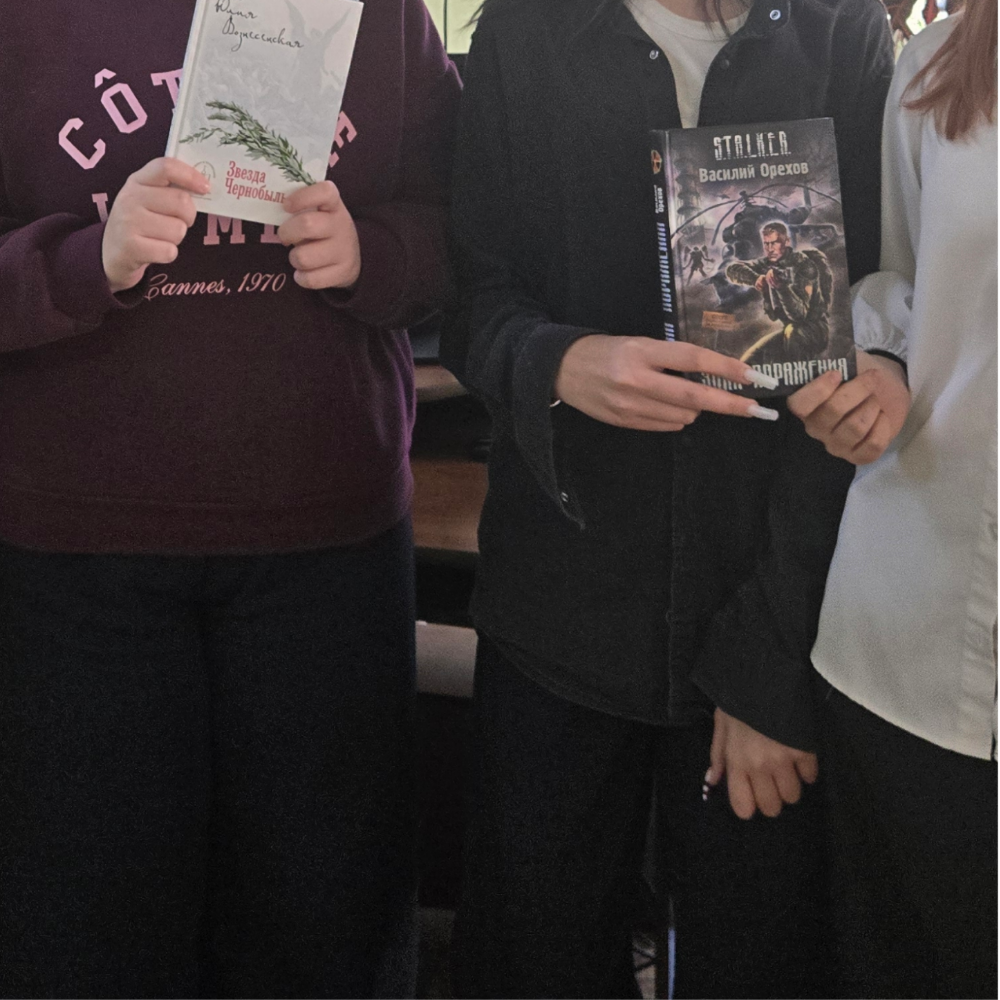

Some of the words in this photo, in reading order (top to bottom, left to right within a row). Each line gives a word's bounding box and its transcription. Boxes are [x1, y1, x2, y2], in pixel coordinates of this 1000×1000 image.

[222, 15, 304, 51] Вознесенская
[227, 160, 266, 185] Звезда
[699, 165, 755, 183] Василий
[760, 162, 809, 180] Орехов
[142, 273, 232, 301] Cannes,
[237, 272, 287, 293] 1970
